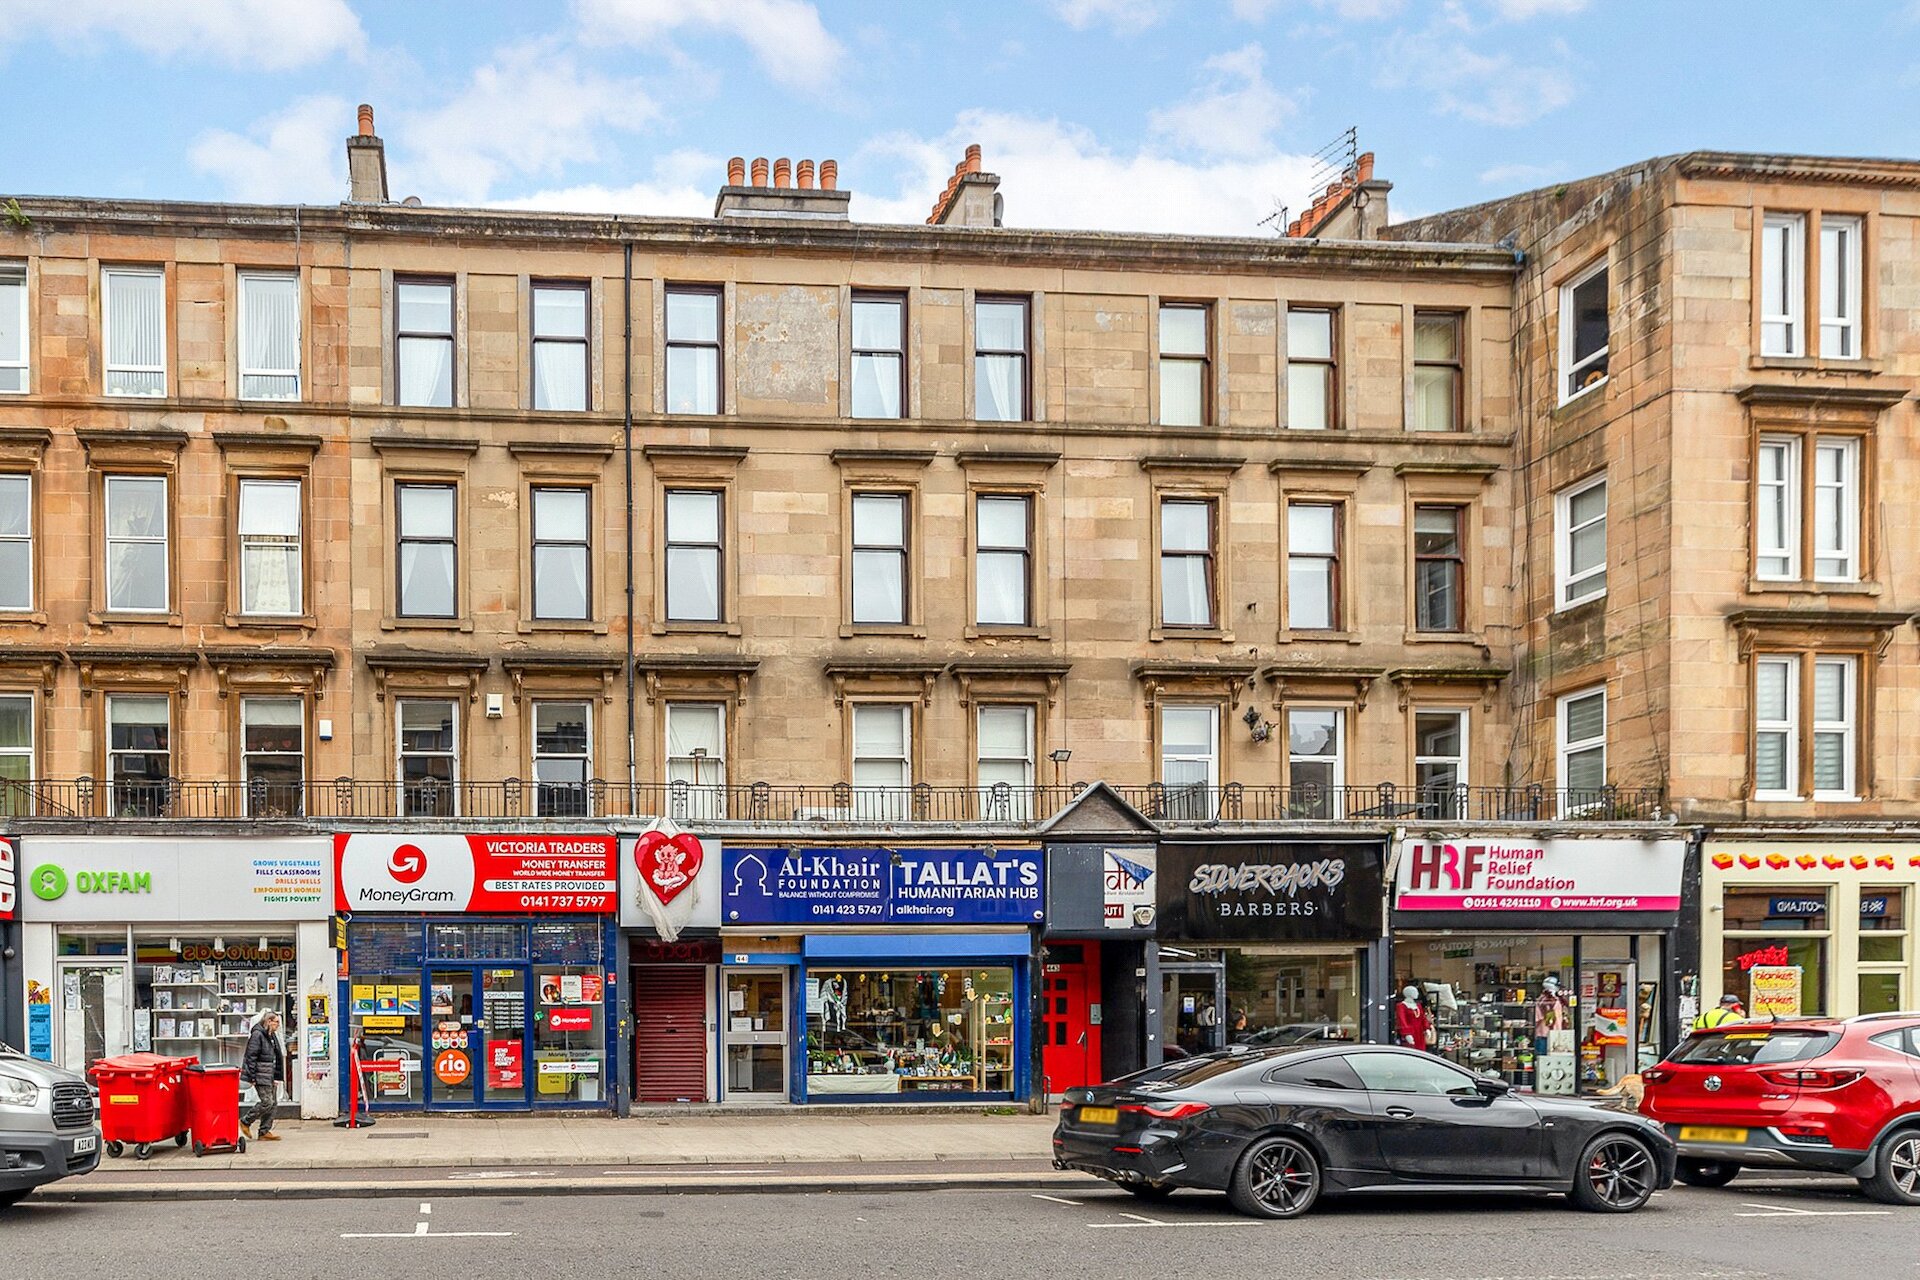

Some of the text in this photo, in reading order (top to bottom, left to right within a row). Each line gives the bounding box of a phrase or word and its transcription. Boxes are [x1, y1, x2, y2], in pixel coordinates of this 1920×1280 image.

[486, 841, 606, 853] VICTORIA TRADERS
[1489, 845, 1544, 860] Human
[521, 859, 606, 869] MONEY TRANSFER
[778, 856, 880, 877] Al-Khair
[1410, 844, 1486, 890] HRF
[1487, 861, 1533, 875] Relief
[899, 859, 1038, 886] TALLAT'S
[1189, 858, 1345, 898] SILVERBACKS
[76, 871, 151, 893] OXFAM
[495, 881, 606, 890] BEST RATES PROVIDED
[778, 879, 881, 890] FOUNDATION
[1487, 875, 1575, 891] Foundation
[359, 887, 454, 905] MoneyGram
[778, 891, 880, 899] BALANCE WITHOUT COMPROMISE
[898, 887, 1039, 899] HUMANITARIAN HUB
[520, 895, 606, 907] 0141 737 5797
[1473, 897, 1542, 908] 0141 4241110
[1562, 897, 1638, 909] www.hrf.org.uk
[812, 905, 883, 915] 0141 423 5747
[896, 904, 955, 917] alkhair.org
[1220, 901, 1314, 917] BARBERS
[439, 1053, 467, 1071] ria
